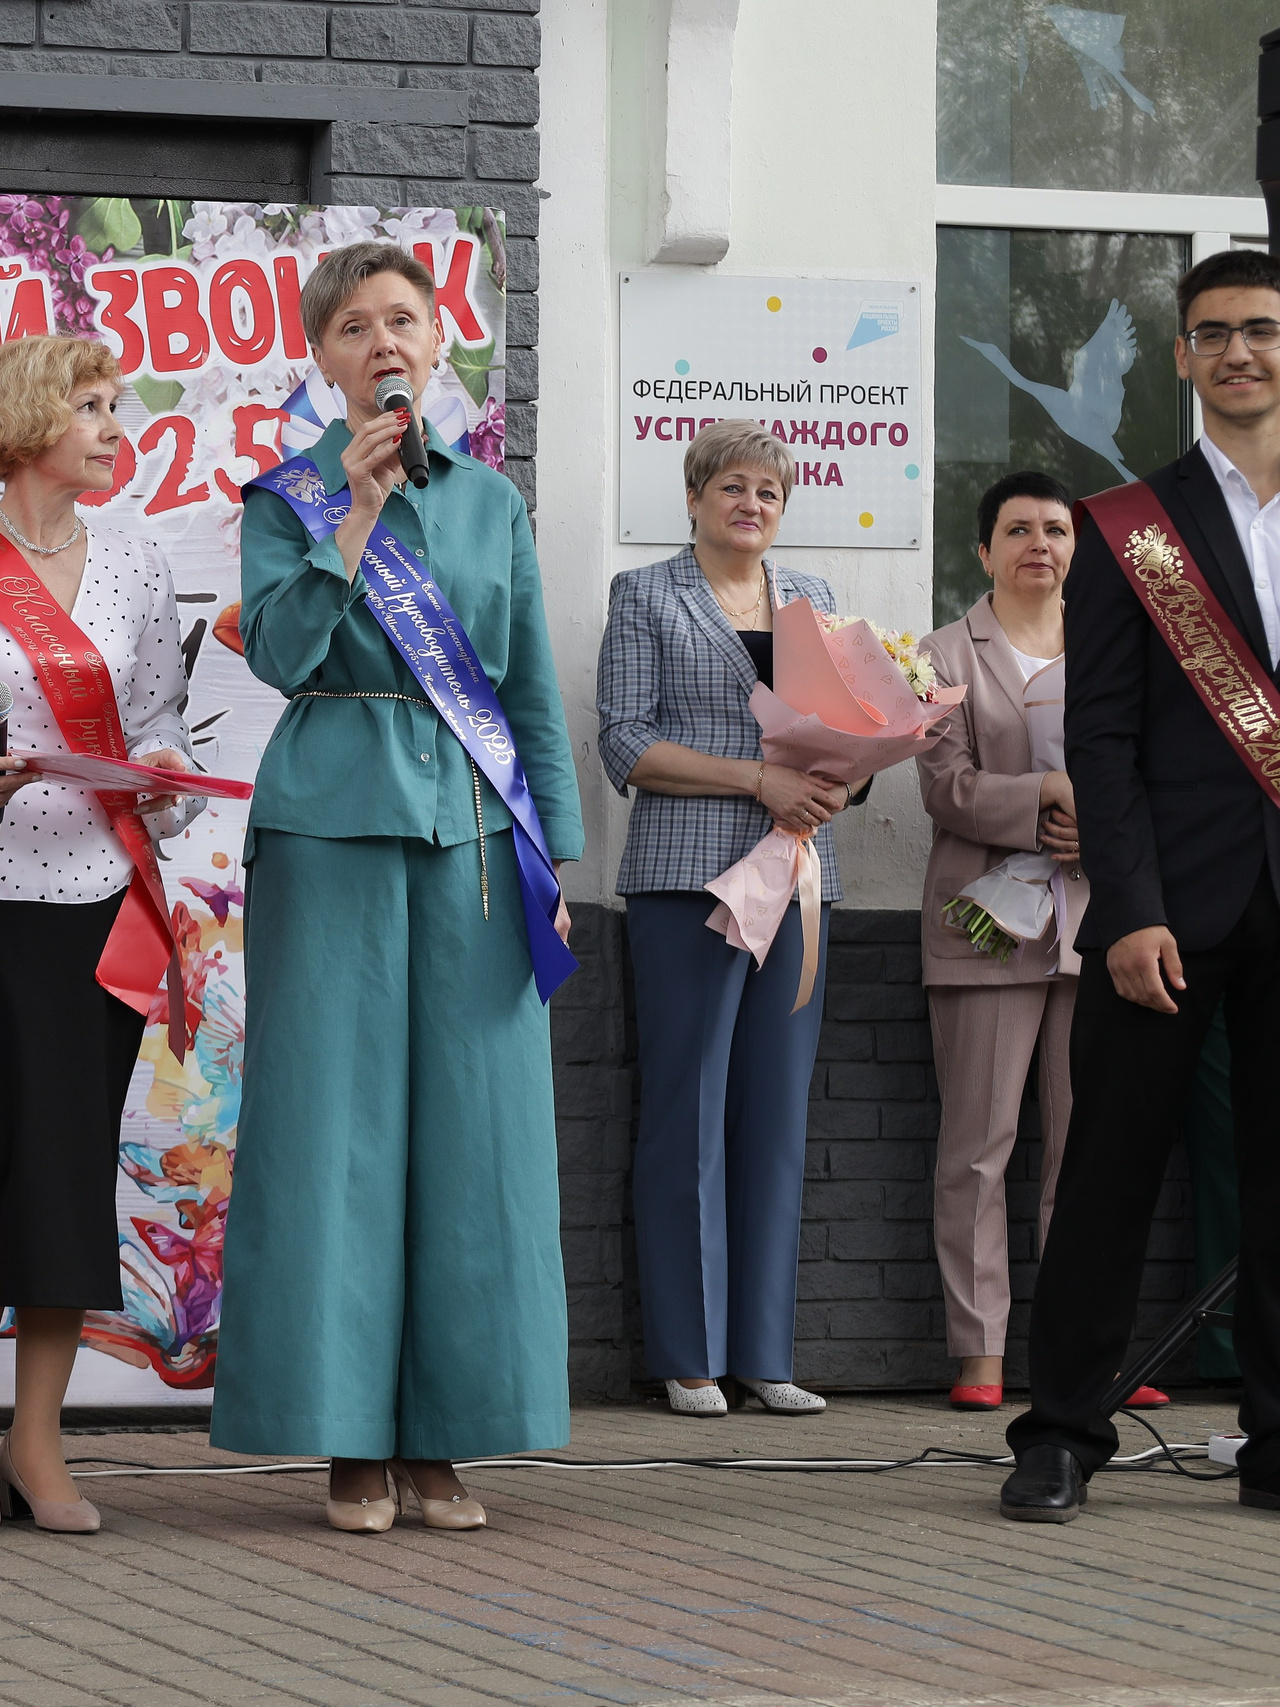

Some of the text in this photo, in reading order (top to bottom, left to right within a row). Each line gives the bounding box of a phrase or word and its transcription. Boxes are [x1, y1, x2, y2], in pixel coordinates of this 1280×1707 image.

[92, 239, 486, 376] ЗВОК
[632, 379, 909, 405] ФЕДЕРАЛЬНЫЙ ПРОЕКТ
[634, 415, 909, 451] УСП АЖДОГО
[381, 536, 424, 582] Данилина
[421, 580, 442, 611] Елена
[383, 591, 470, 710] руководитель
[465, 708, 517, 765] 2025
[1152, 579, 1273, 742] Выпускник
